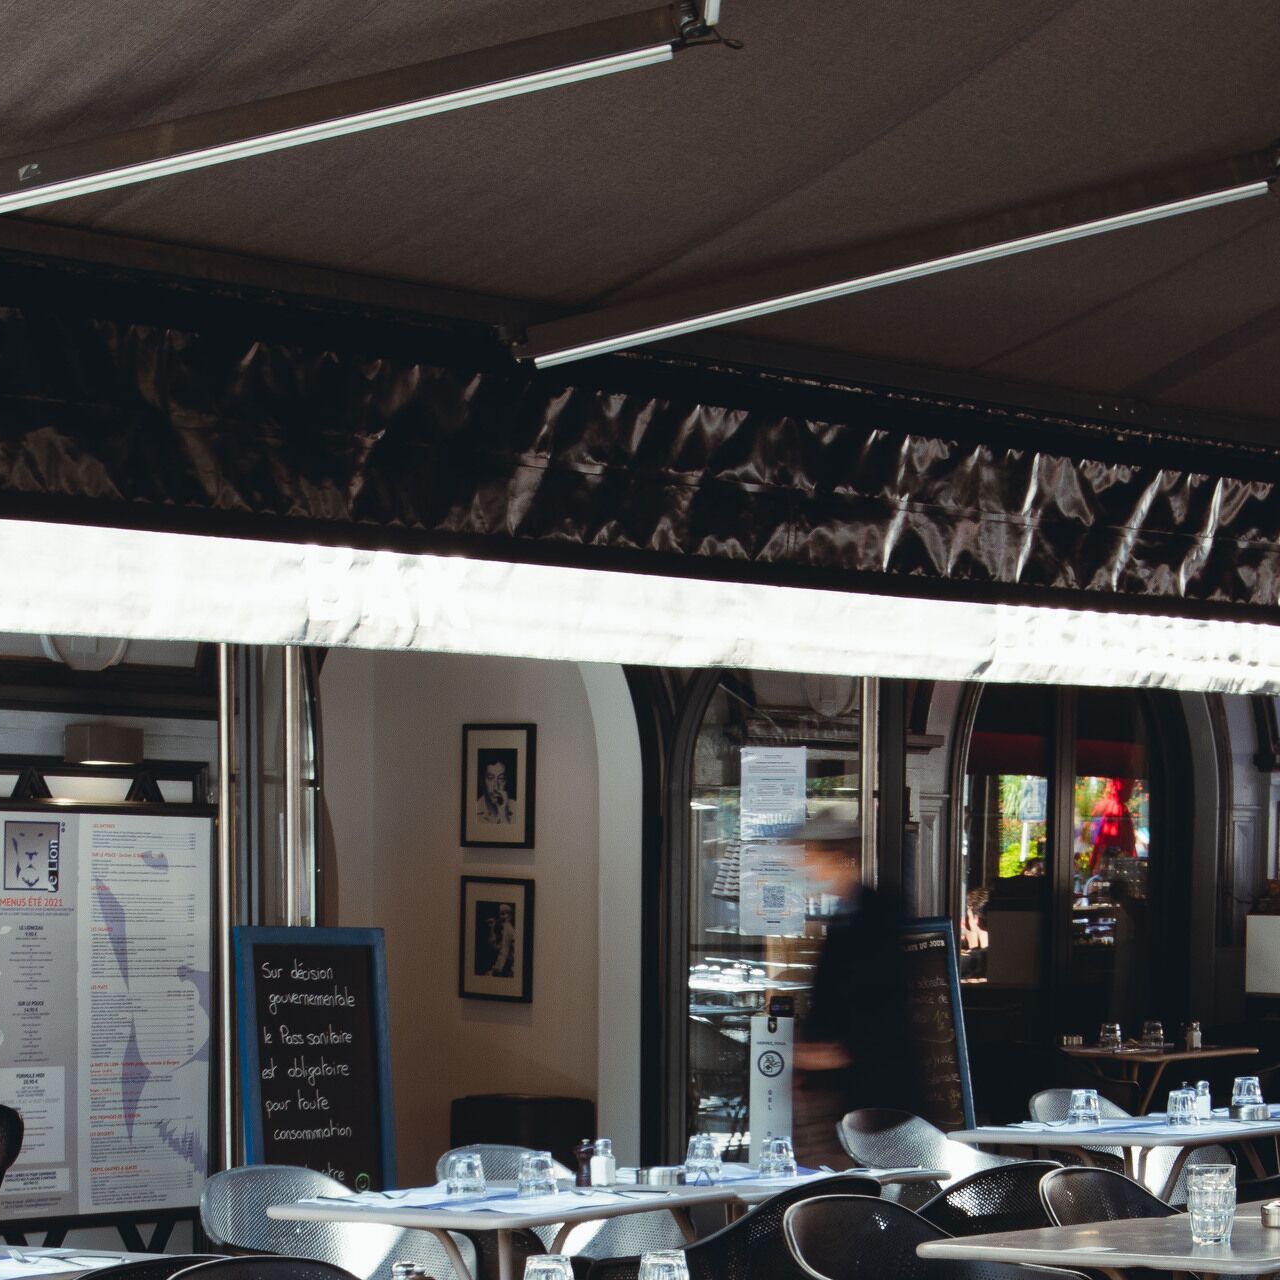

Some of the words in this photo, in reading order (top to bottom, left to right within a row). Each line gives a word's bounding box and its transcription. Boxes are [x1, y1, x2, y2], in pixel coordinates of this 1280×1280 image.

[0, 897, 26, 907] MENUS
[28, 896, 43, 907] ÉTÉ
[44, 897, 64, 907] 2021
[261, 962, 283, 980] Sur
[290, 958, 334, 982] décision
[263, 1025, 273, 1045] le
[280, 1024, 305, 1045] Pass
[306, 1023, 353, 1046] sanitaire
[261, 1057, 279, 1080] est
[287, 1055, 350, 1087] obligatoire
[265, 1098, 292, 1119] pour
[297, 1088, 331, 1111] toute
[273, 1118, 353, 1141] consommation
